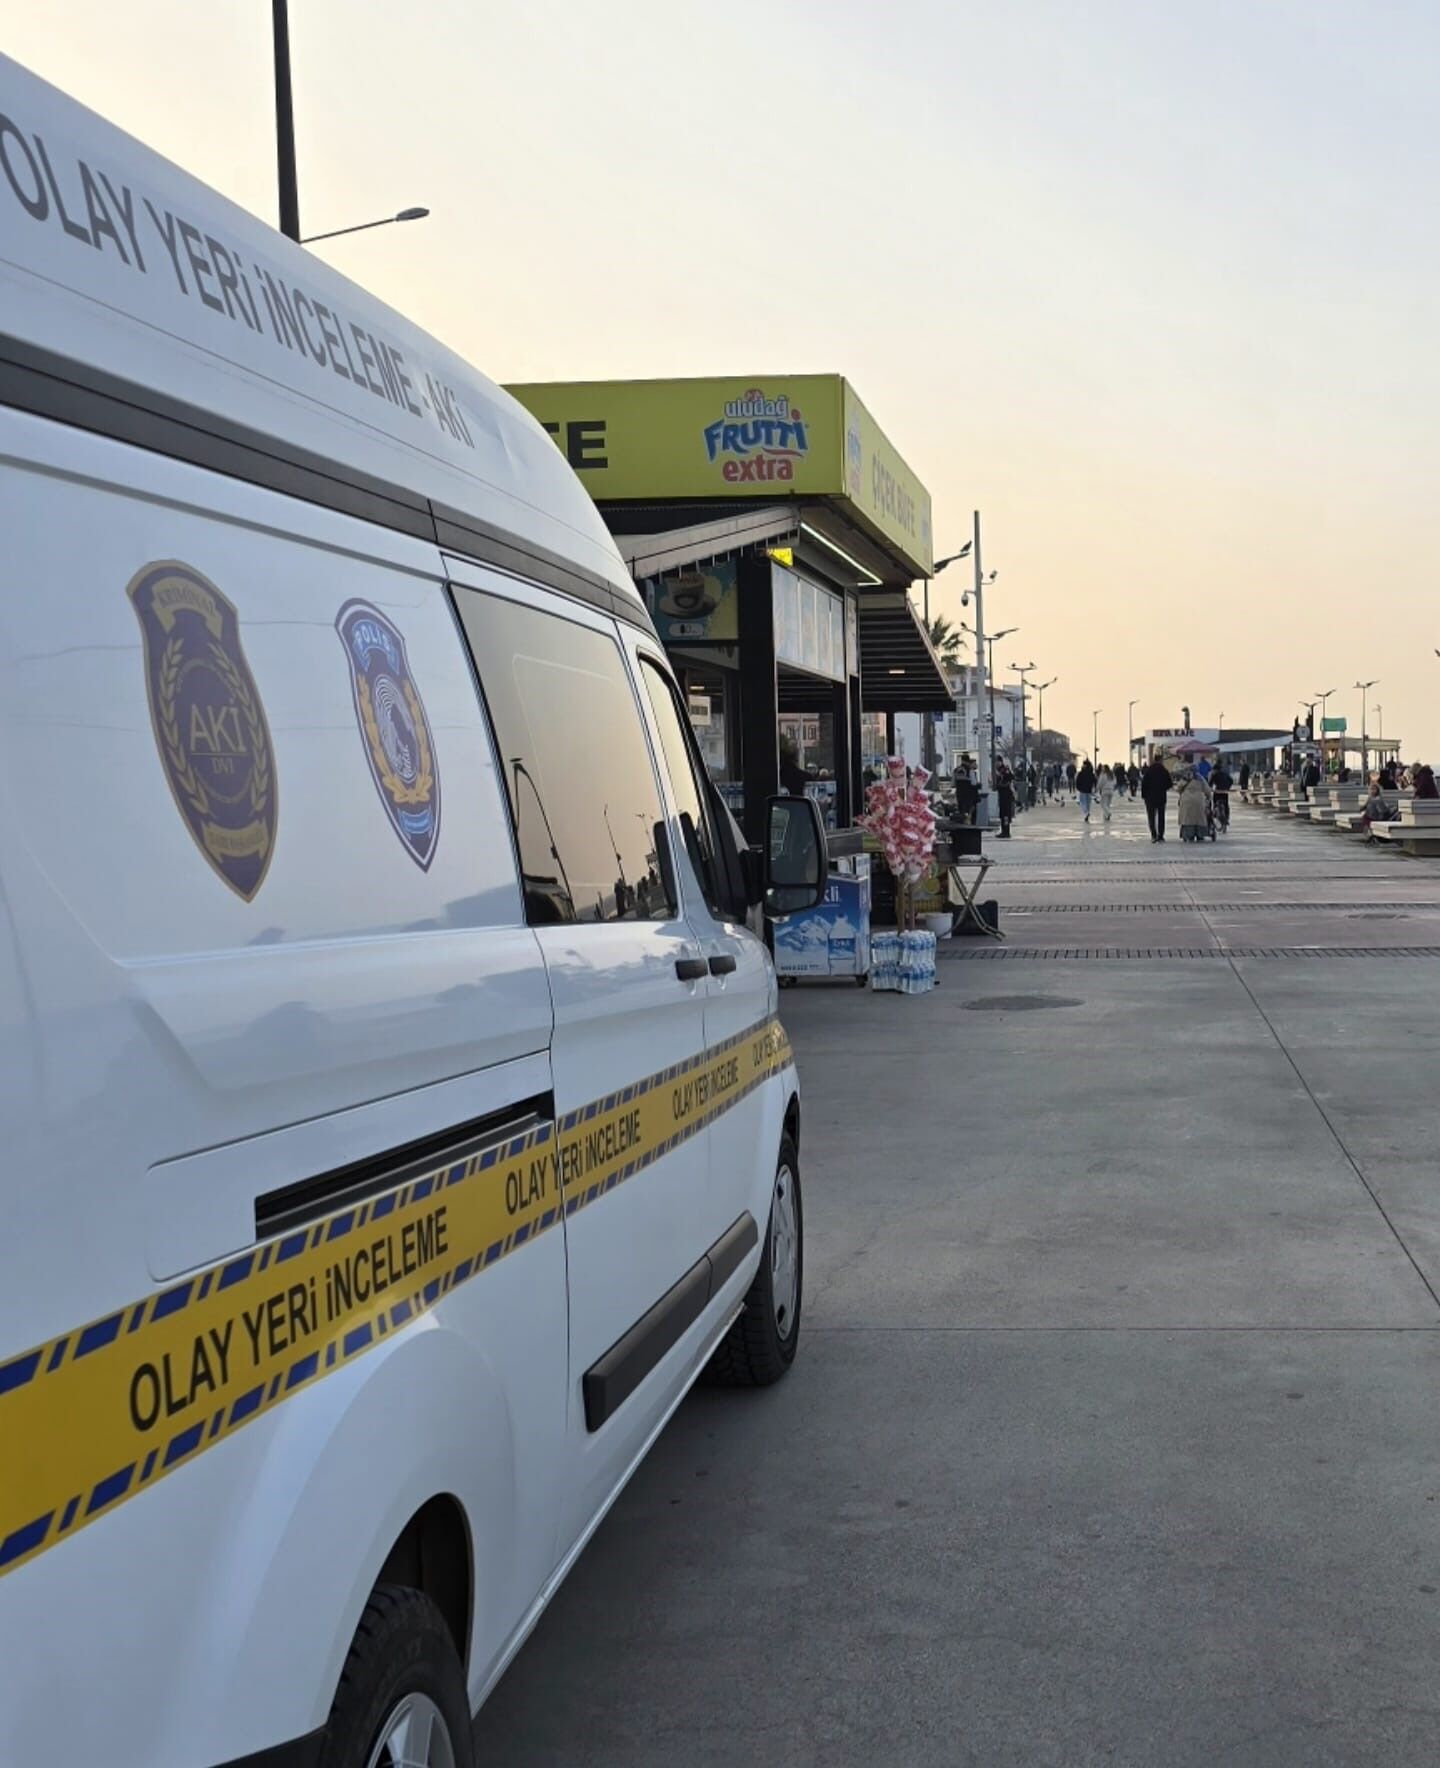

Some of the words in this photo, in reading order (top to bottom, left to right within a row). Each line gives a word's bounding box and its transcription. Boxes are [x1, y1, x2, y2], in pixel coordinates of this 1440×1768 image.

[0, 112, 147, 274] OLAY
[724, 395, 789, 419] uludağ
[722, 454, 794, 483] extra
[673, 1080, 694, 1121] OLAY
[505, 1156, 548, 1216] OLAY
[129, 1320, 234, 1432] OLAY
